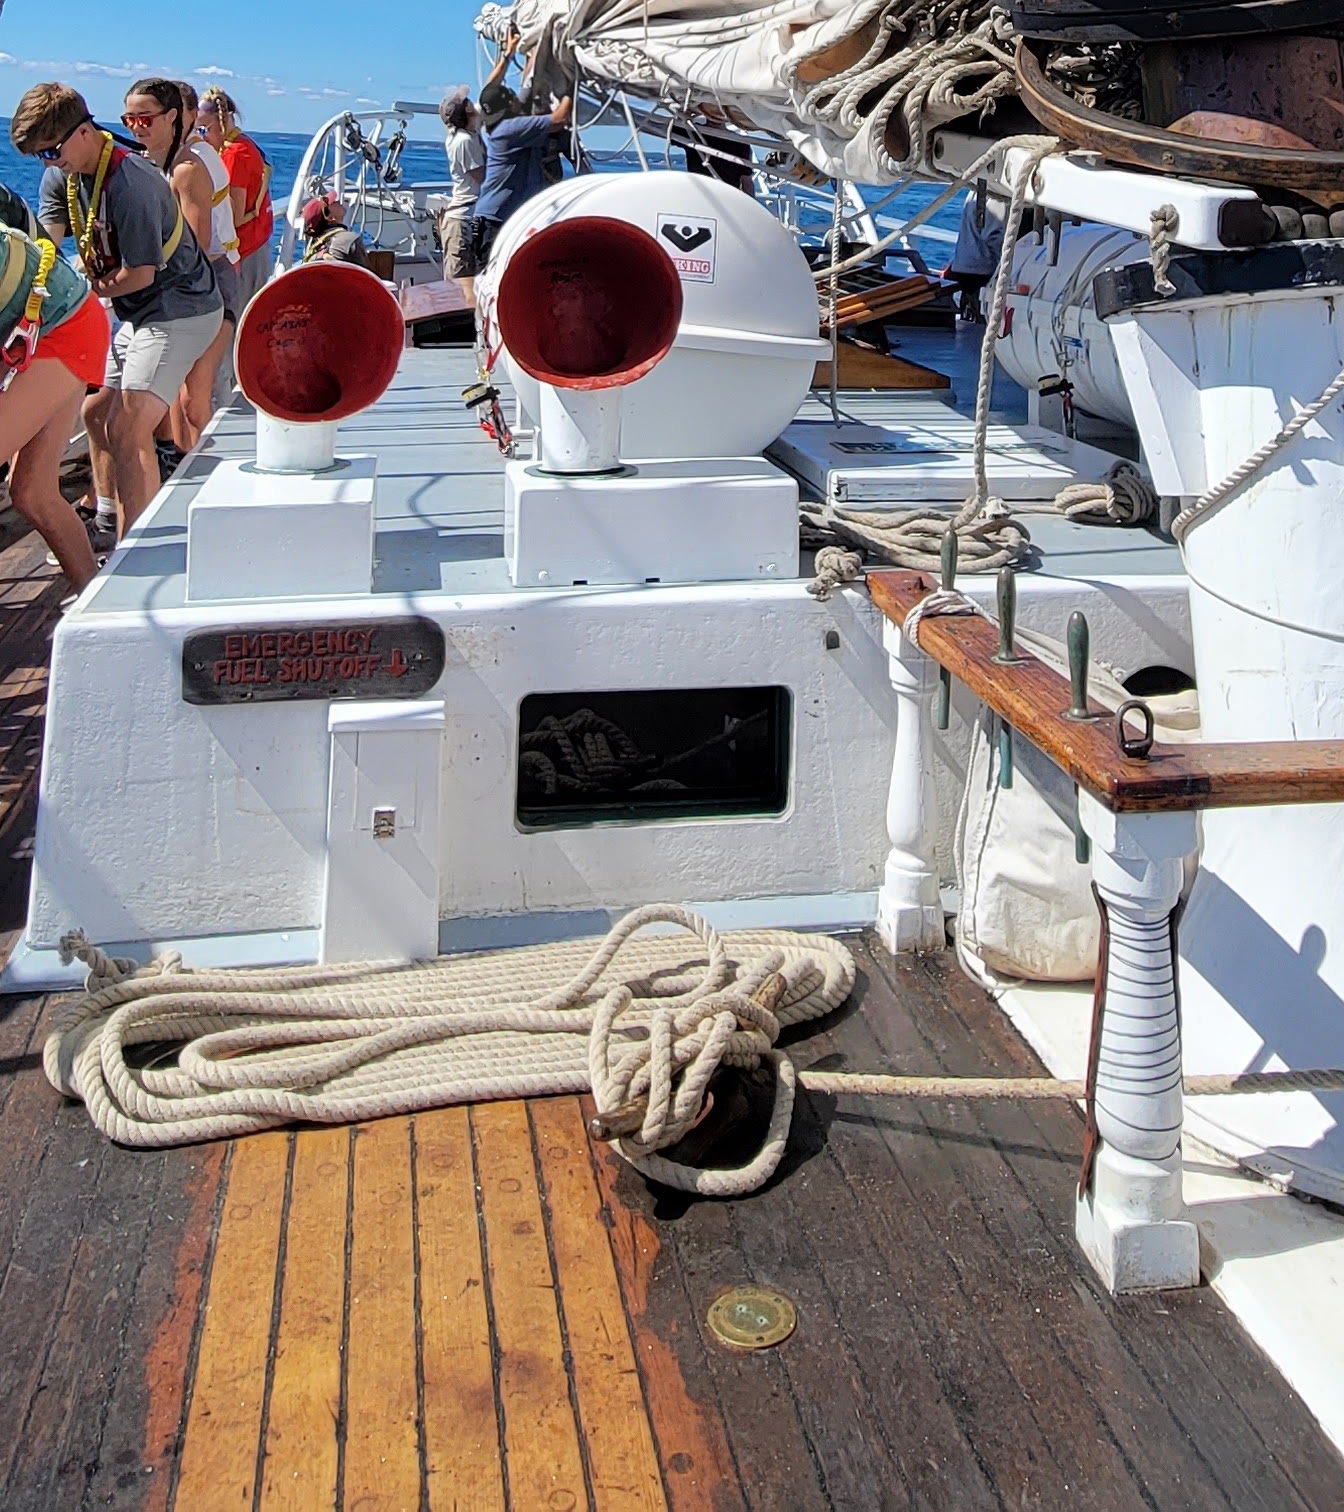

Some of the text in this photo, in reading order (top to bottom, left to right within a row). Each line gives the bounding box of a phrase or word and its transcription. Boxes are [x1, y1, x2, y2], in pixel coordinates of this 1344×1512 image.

[675, 260, 709, 273] KING
[225, 630, 376, 658] EMERGENCY
[212, 656, 381, 685] FUEL SHUTOFF
